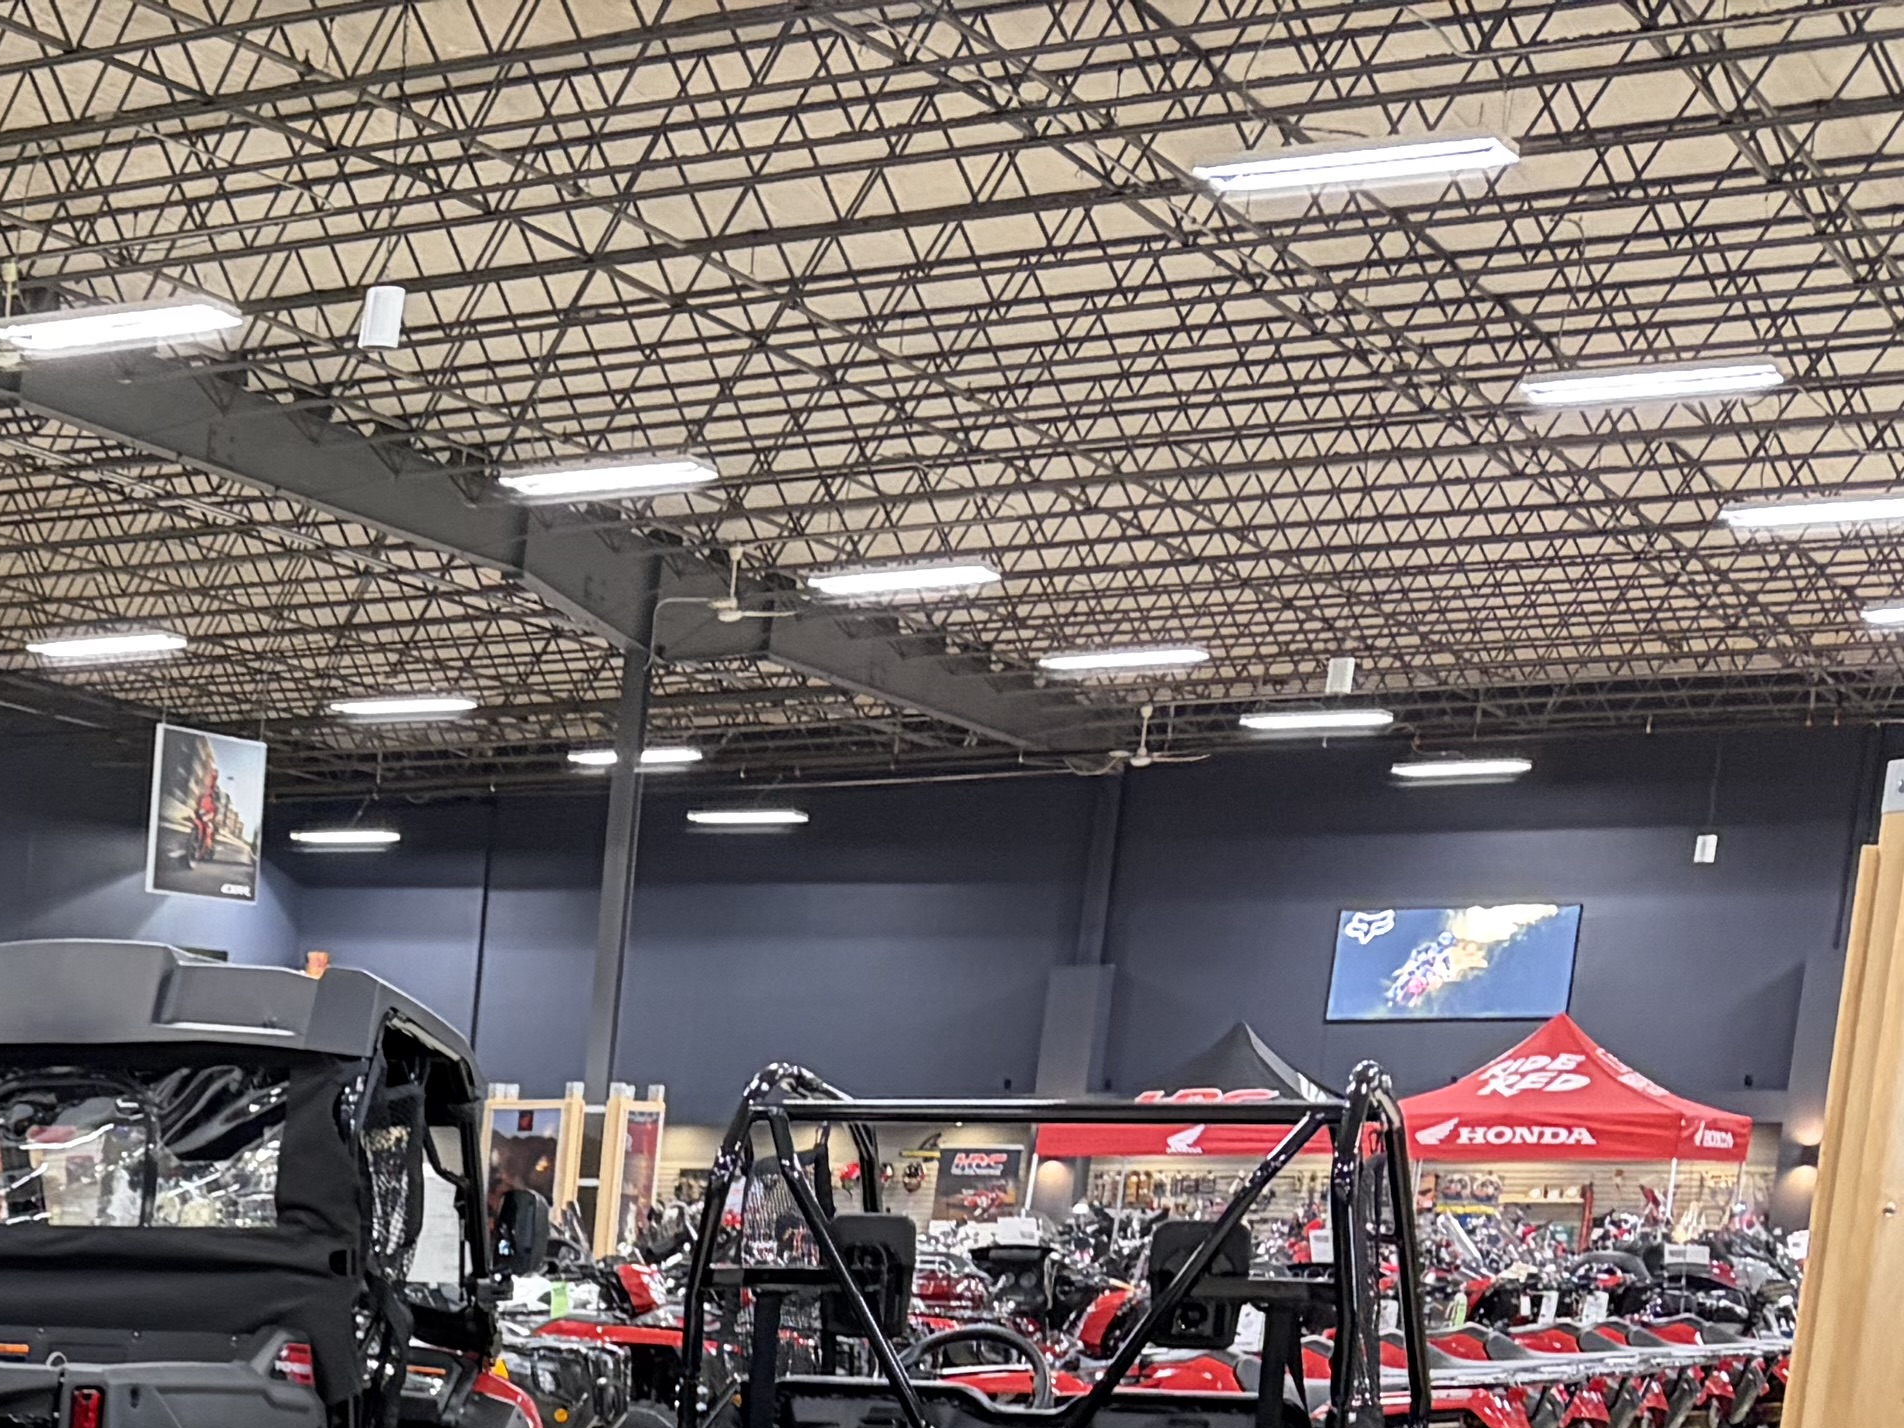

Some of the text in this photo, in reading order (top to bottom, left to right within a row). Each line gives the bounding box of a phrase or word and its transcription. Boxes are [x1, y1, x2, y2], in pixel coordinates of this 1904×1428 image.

[1478, 1053, 1586, 1082] RIDE
[1477, 1071, 1591, 1098] RED
[1456, 1126, 1597, 1145] HONDA
